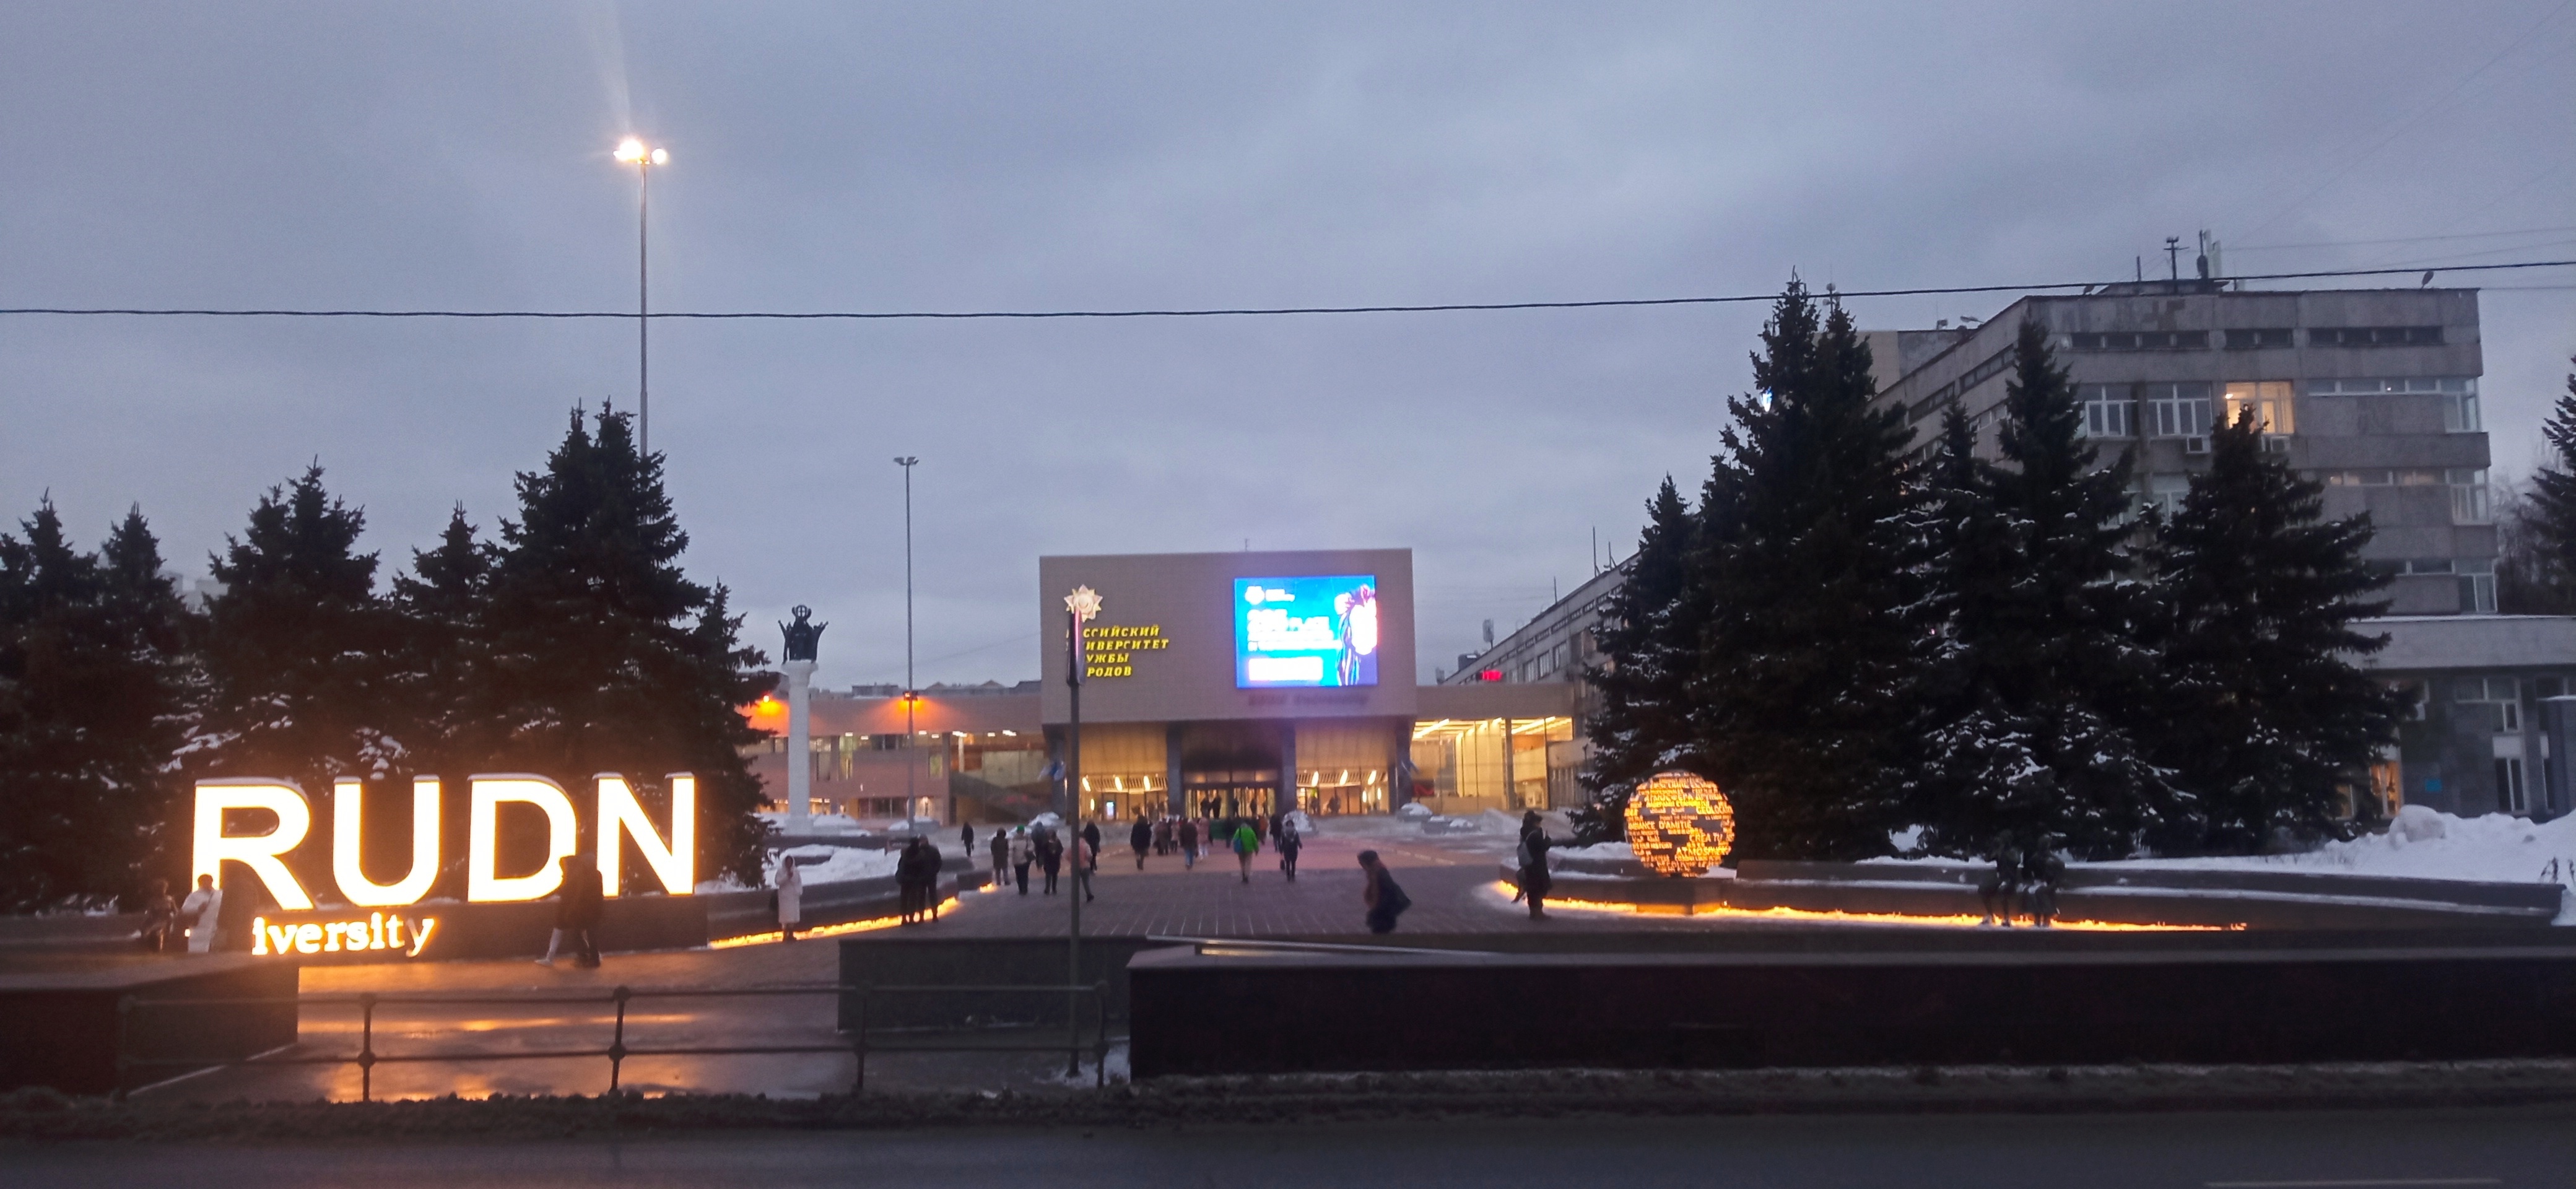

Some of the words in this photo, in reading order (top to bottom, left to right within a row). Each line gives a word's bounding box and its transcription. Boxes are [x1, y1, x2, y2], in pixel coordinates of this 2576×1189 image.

[1066, 625, 1160, 638] ССИЙСКИЙ
[1066, 639, 1169, 651] ИВЕРСИТЕТ
[1086, 653, 1129, 663] УЖБЫ
[1086, 666, 1132, 677] РОДОВ
[191, 773, 698, 910] RUDN
[252, 912, 435, 957] iversity
